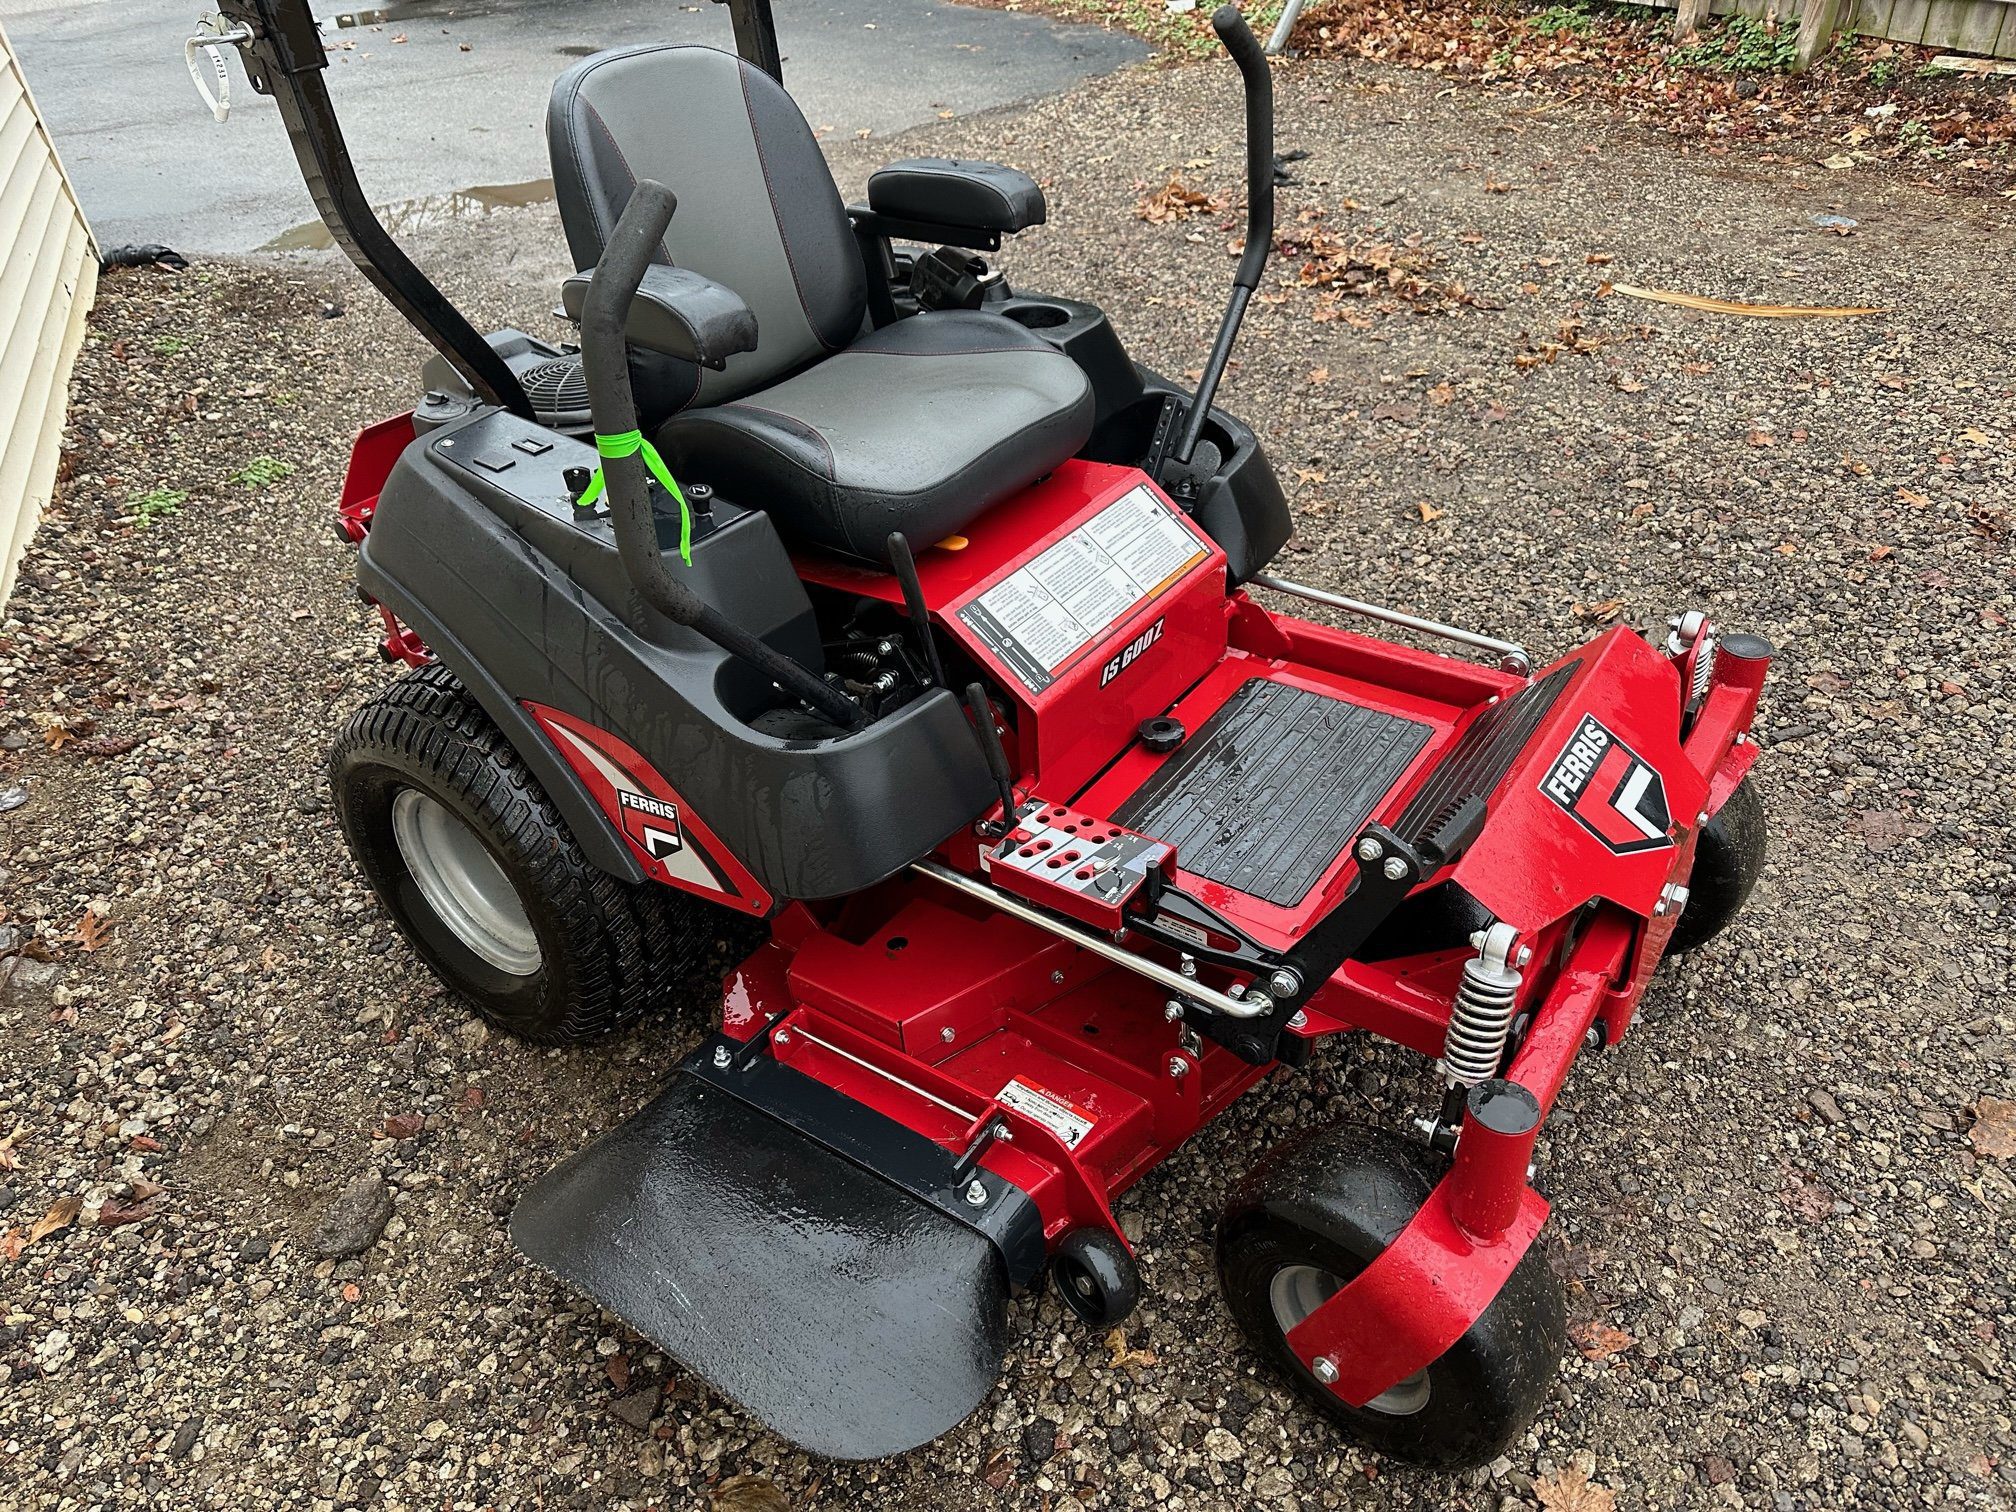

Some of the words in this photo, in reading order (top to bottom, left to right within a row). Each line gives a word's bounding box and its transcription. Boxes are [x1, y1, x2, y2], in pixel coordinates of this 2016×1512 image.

[1101, 656, 1120, 687] IS
[1121, 618, 1165, 669] 600Z
[1546, 722, 1609, 805] FERRIS
[620, 791, 675, 820] FERRIS
[1044, 1090, 1074, 1110] DANGER
